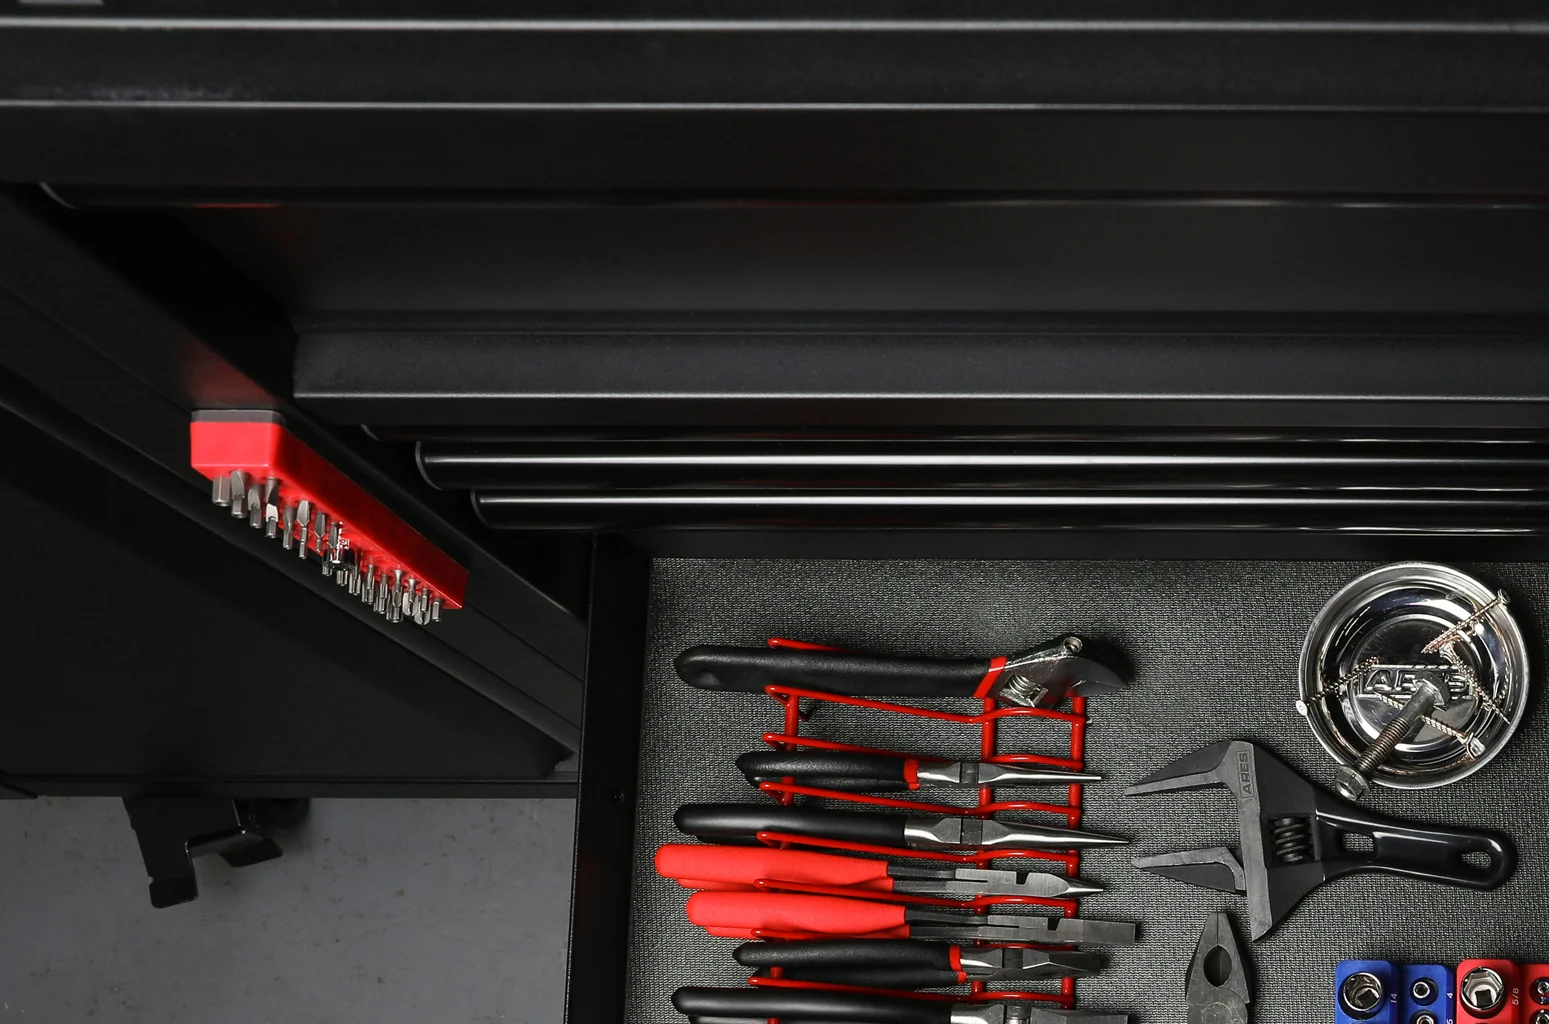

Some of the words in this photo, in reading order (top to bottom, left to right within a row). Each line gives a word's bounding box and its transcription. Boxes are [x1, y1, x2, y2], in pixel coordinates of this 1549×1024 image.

[1239, 753, 1252, 794] ARES
[1390, 993, 1398, 1003] 14
[1512, 987, 1520, 1006] 5/8
